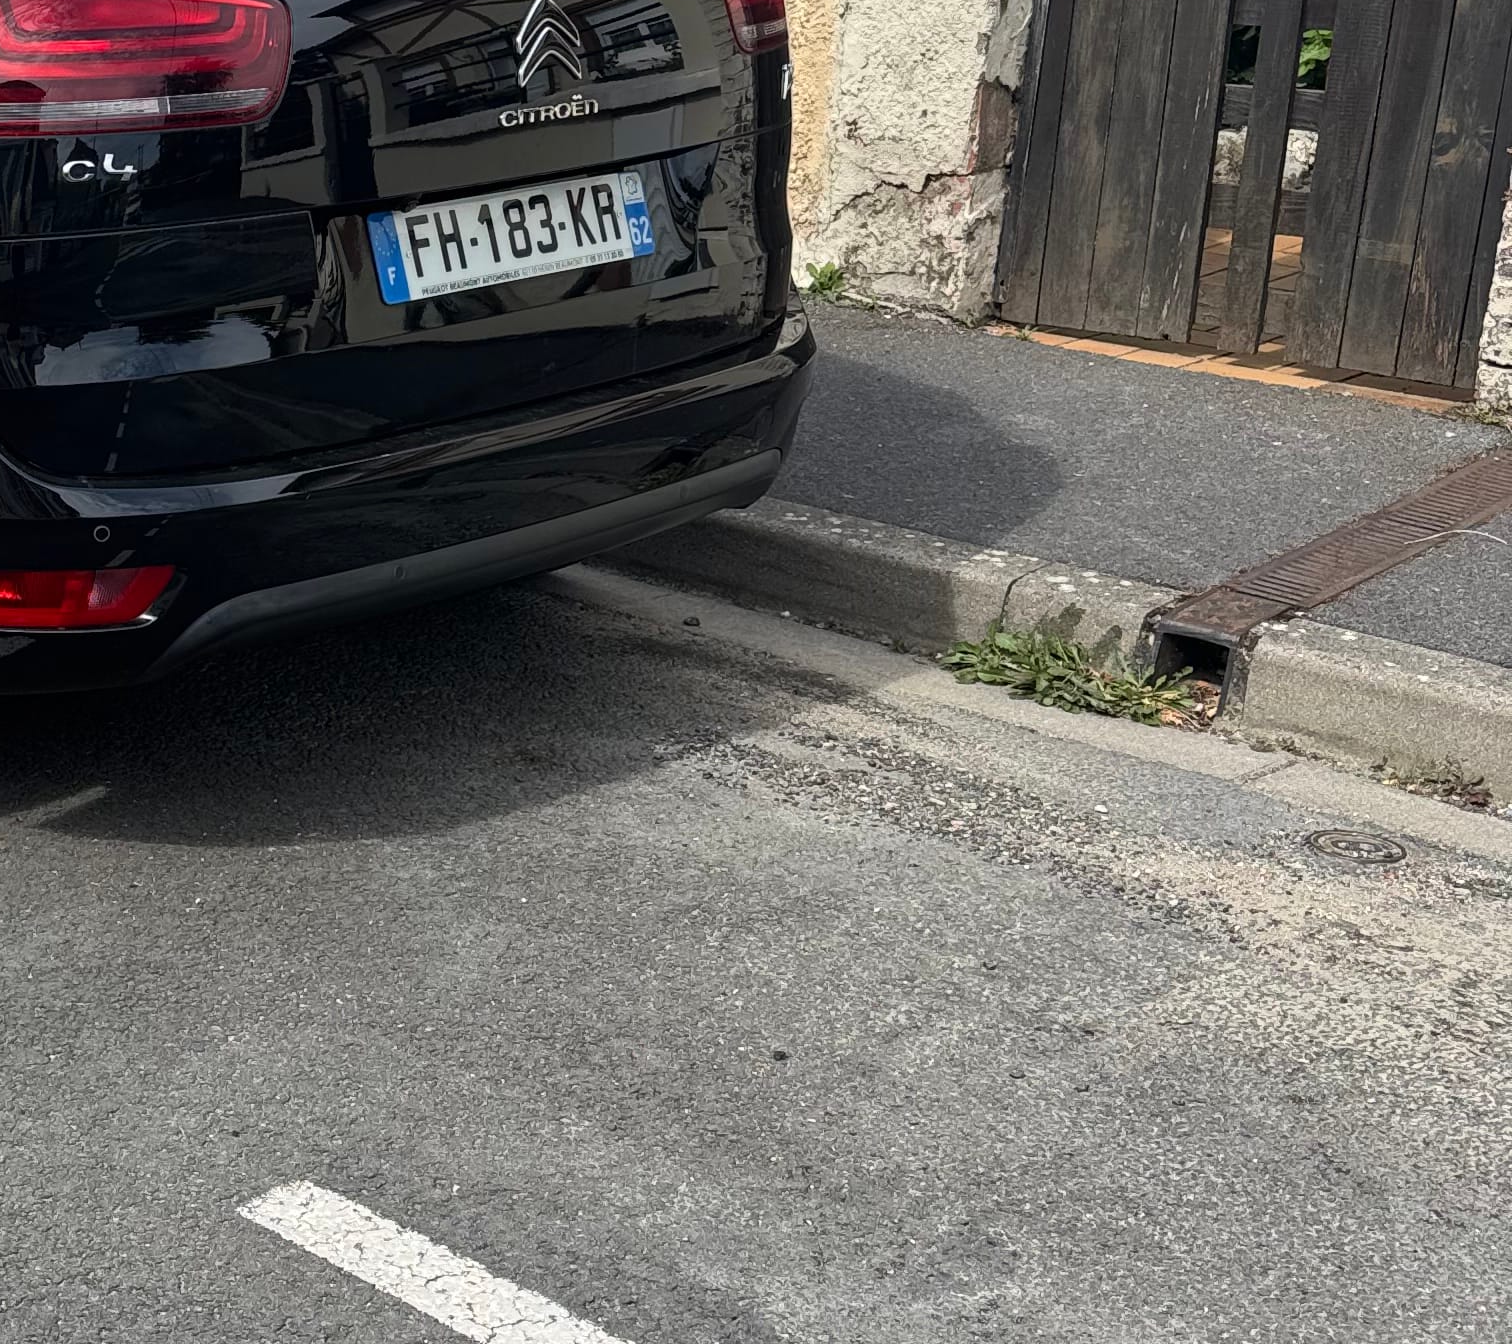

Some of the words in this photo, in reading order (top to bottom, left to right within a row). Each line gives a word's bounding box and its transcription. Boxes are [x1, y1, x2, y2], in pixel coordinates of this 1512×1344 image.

[62, 153, 138, 183] C4
[404, 183, 622, 278] FH-183-KR
[629, 215, 653, 246] 62
[387, 266, 397, 286] F
